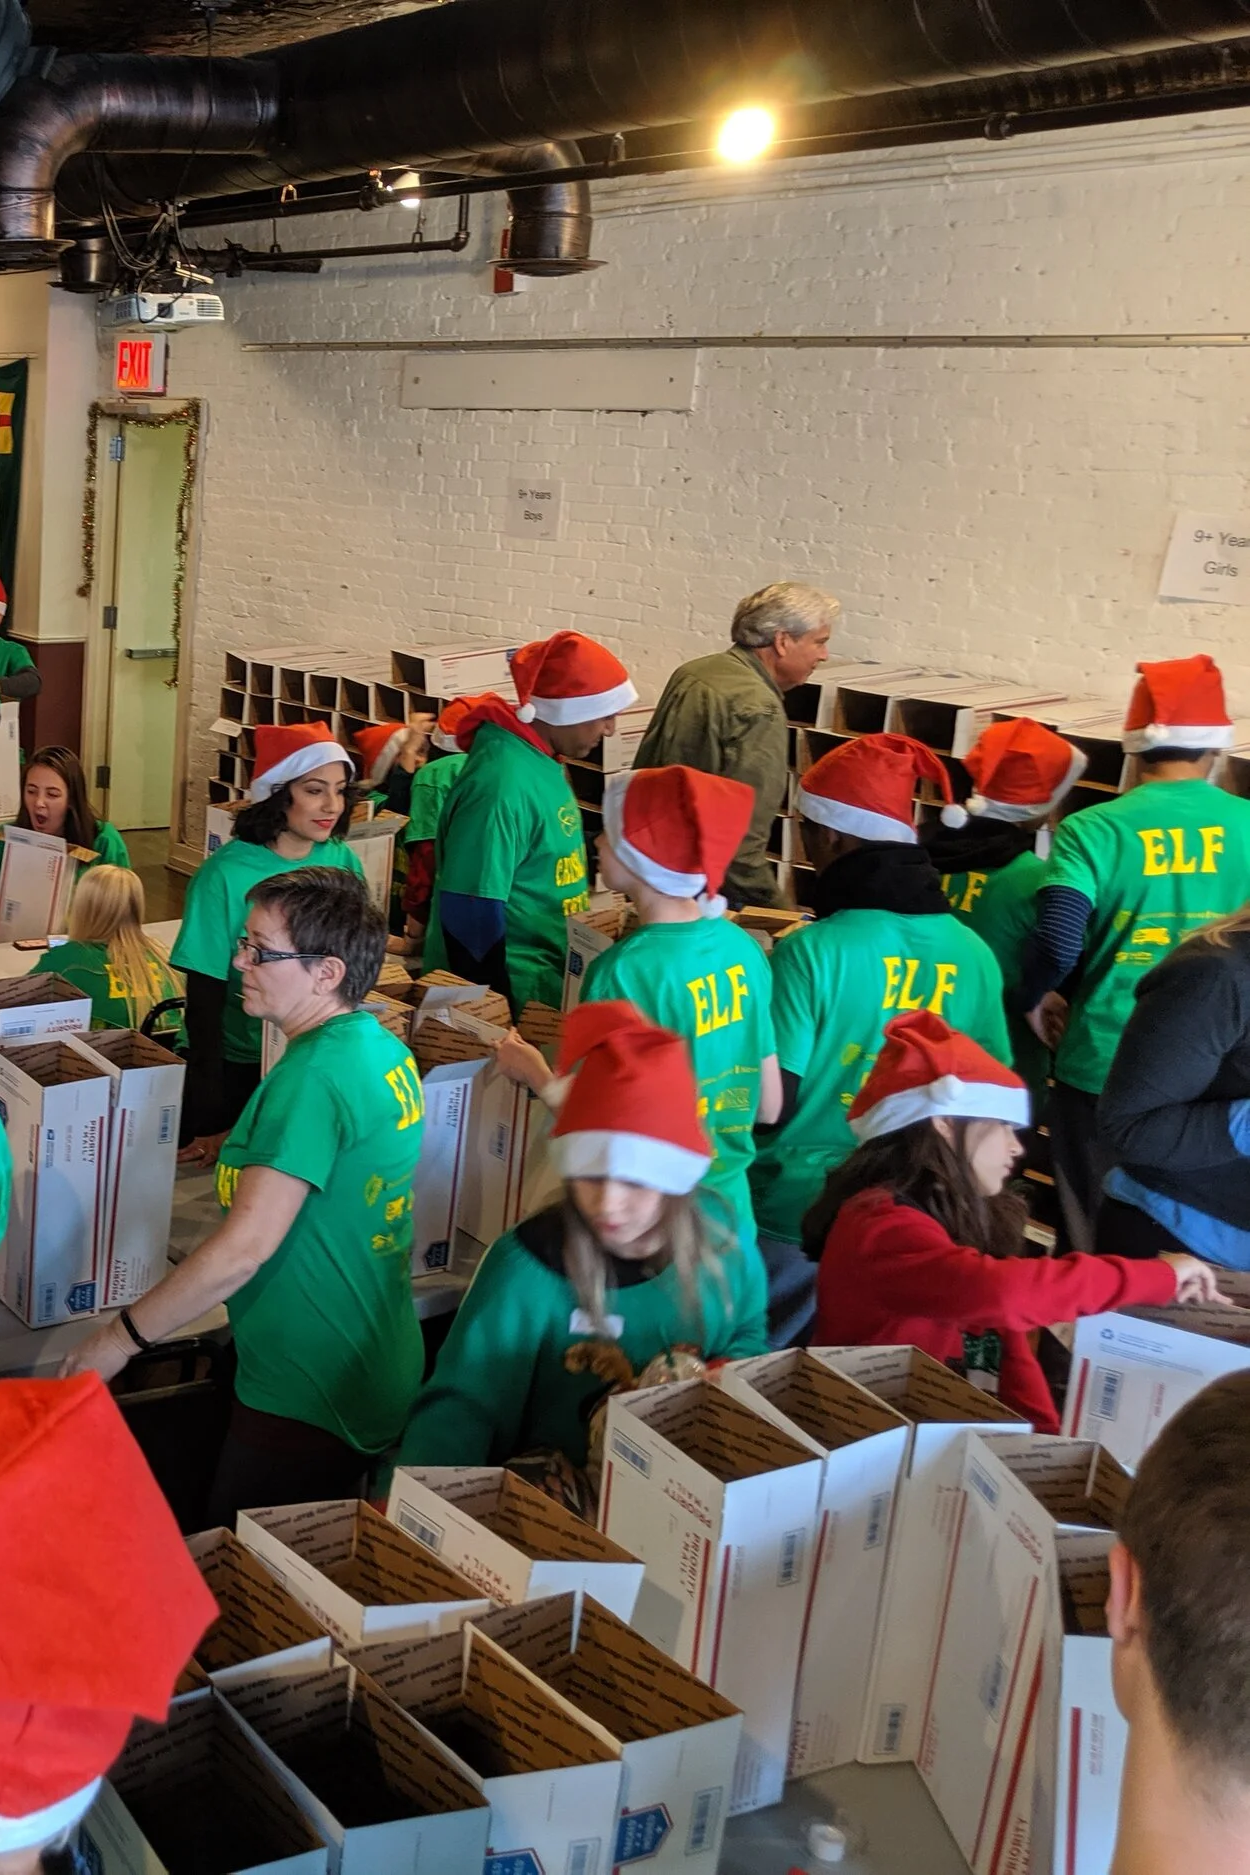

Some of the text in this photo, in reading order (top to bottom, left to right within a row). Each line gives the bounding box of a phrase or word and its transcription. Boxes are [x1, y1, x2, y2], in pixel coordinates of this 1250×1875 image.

[117, 341, 153, 388] EXIT
[523, 510, 543, 522] Boys
[1193, 529, 1214, 543] 9+
[1204, 560, 1239, 577] Girls
[1137, 826, 1225, 875] ELF
[940, 871, 988, 912] LF
[686, 965, 749, 1037] ELF
[882, 956, 958, 1016] ELF
[43, 1023, 83, 1033] PRIORITY
[88, 1120, 97, 1164] PRIORITY
[111, 1259, 122, 1300] PRIORITY
[663, 1486, 713, 1529] PRIORITY
[676, 1482, 702, 1506] MAIL
[473, 1558, 502, 1584] MAIL
[680, 1541, 690, 1573] MAIL
[686, 1533, 700, 1598] PRIORITY
[314, 1604, 339, 1632] MAIL
